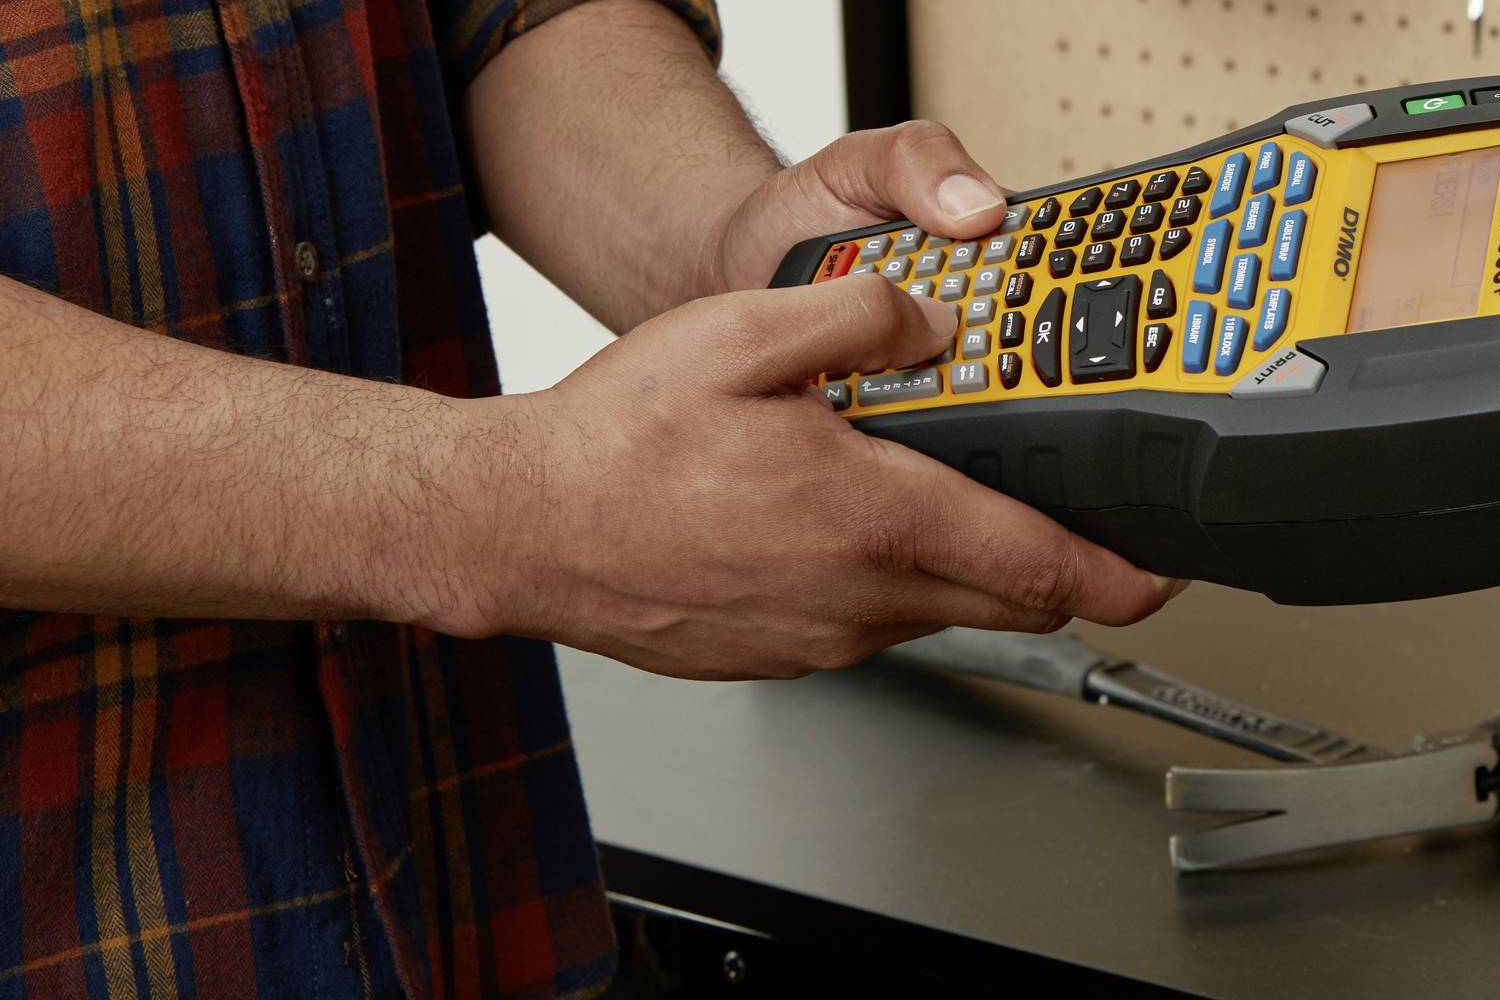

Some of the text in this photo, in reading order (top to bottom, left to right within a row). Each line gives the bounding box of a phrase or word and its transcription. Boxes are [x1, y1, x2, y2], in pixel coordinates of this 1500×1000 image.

[1307, 113, 1336, 128] CUT
[1259, 151, 1273, 170] PANEL
[1220, 163, 1236, 192] BARCODE
[1291, 159, 1306, 187] GENERAL
[1116, 183, 1129, 192] 7
[1140, 205, 1153, 214] 5
[1178, 199, 1191, 209] 2
[1101, 213, 1114, 223] 8
[1245, 201, 1260, 231] BREAKER
[902, 233, 914, 242] P
[1167, 230, 1180, 239] 3
[867, 240, 881, 249] U
[990, 241, 1003, 251] B
[1129, 237, 1142, 247] 6
[1278, 219, 1295, 262] CABLE WRAP
[1333, 206, 1361, 279] DYMO
[956, 247, 969, 258] G
[1091, 244, 1103, 255] 9
[1202, 238, 1217, 266] SYMBOL
[922, 256, 935, 264] L
[823, 254, 838, 278] SHIFT
[886, 261, 901, 272] Q
[980, 272, 993, 281] C
[1233, 257, 1249, 292] TERMINAL
[945, 278, 959, 289] H
[910, 284, 924, 295] M
[1152, 287, 1165, 306] CLR
[972, 302, 986, 312] D
[1263, 289, 1281, 331] TEMPLATES
[1036, 321, 1052, 345] OK
[1188, 313, 1203, 345] LIBRARY
[967, 334, 981, 344] E
[1146, 326, 1159, 348] ESC
[1220, 317, 1236, 357] 110 BLOCK
[1254, 351, 1297, 385] PRINT
[826, 388, 841, 398] Z
